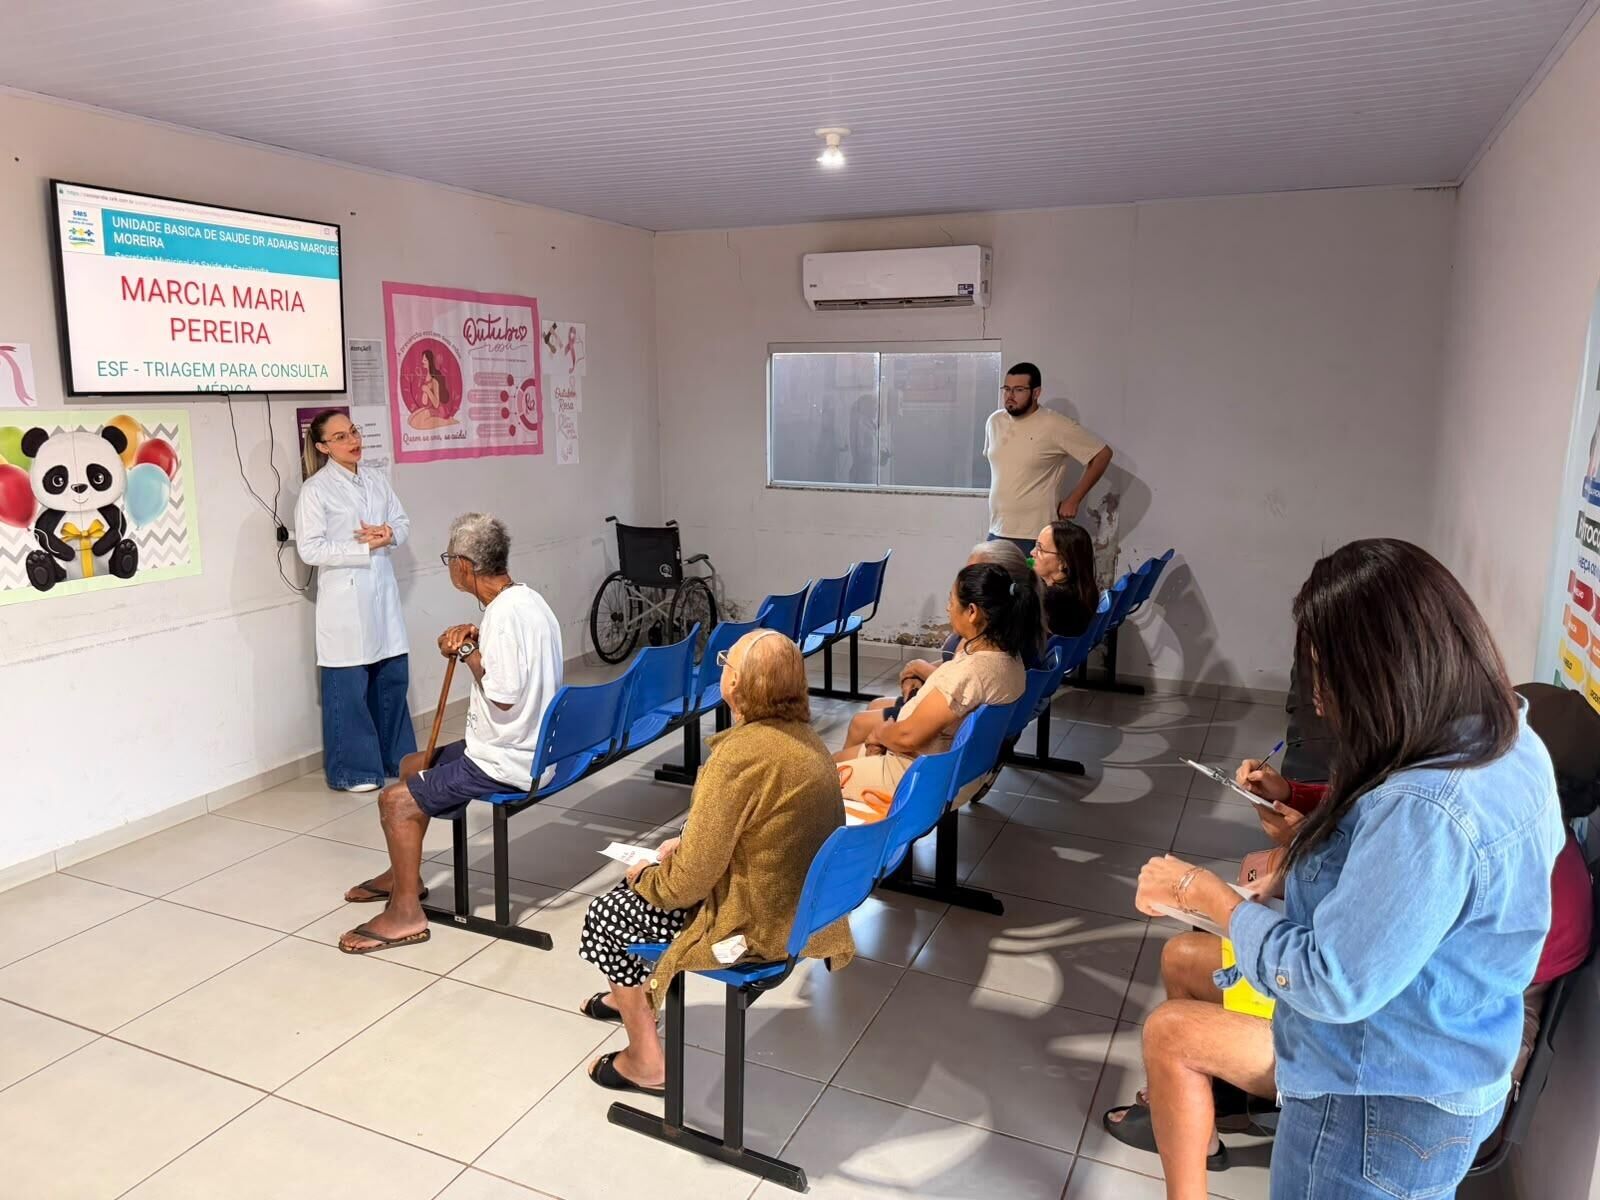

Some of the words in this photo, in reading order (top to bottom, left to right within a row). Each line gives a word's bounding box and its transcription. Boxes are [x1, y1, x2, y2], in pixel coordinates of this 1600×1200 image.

[112, 216, 162, 233] UNIDADE
[164, 223, 202, 238] BASICA
[203, 229, 217, 240] DE
[219, 230, 251, 245] SAUDE
[252, 235, 265, 247] DR
[266, 237, 299, 251] ADAIAS
[300, 242, 339, 256] MARQUES
[113, 232, 165, 248] MOREIRA
[121, 275, 226, 307] MARCIA
[232, 285, 305, 312] MARIA
[170, 317, 271, 344] PEREIRA
[463, 313, 527, 346] Outubro
[97, 361, 129, 377] ESF
[143, 361, 215, 377] TRIAGEM
[219, 362, 257, 377] PARA
[261, 363, 329, 378] CONSULTA
